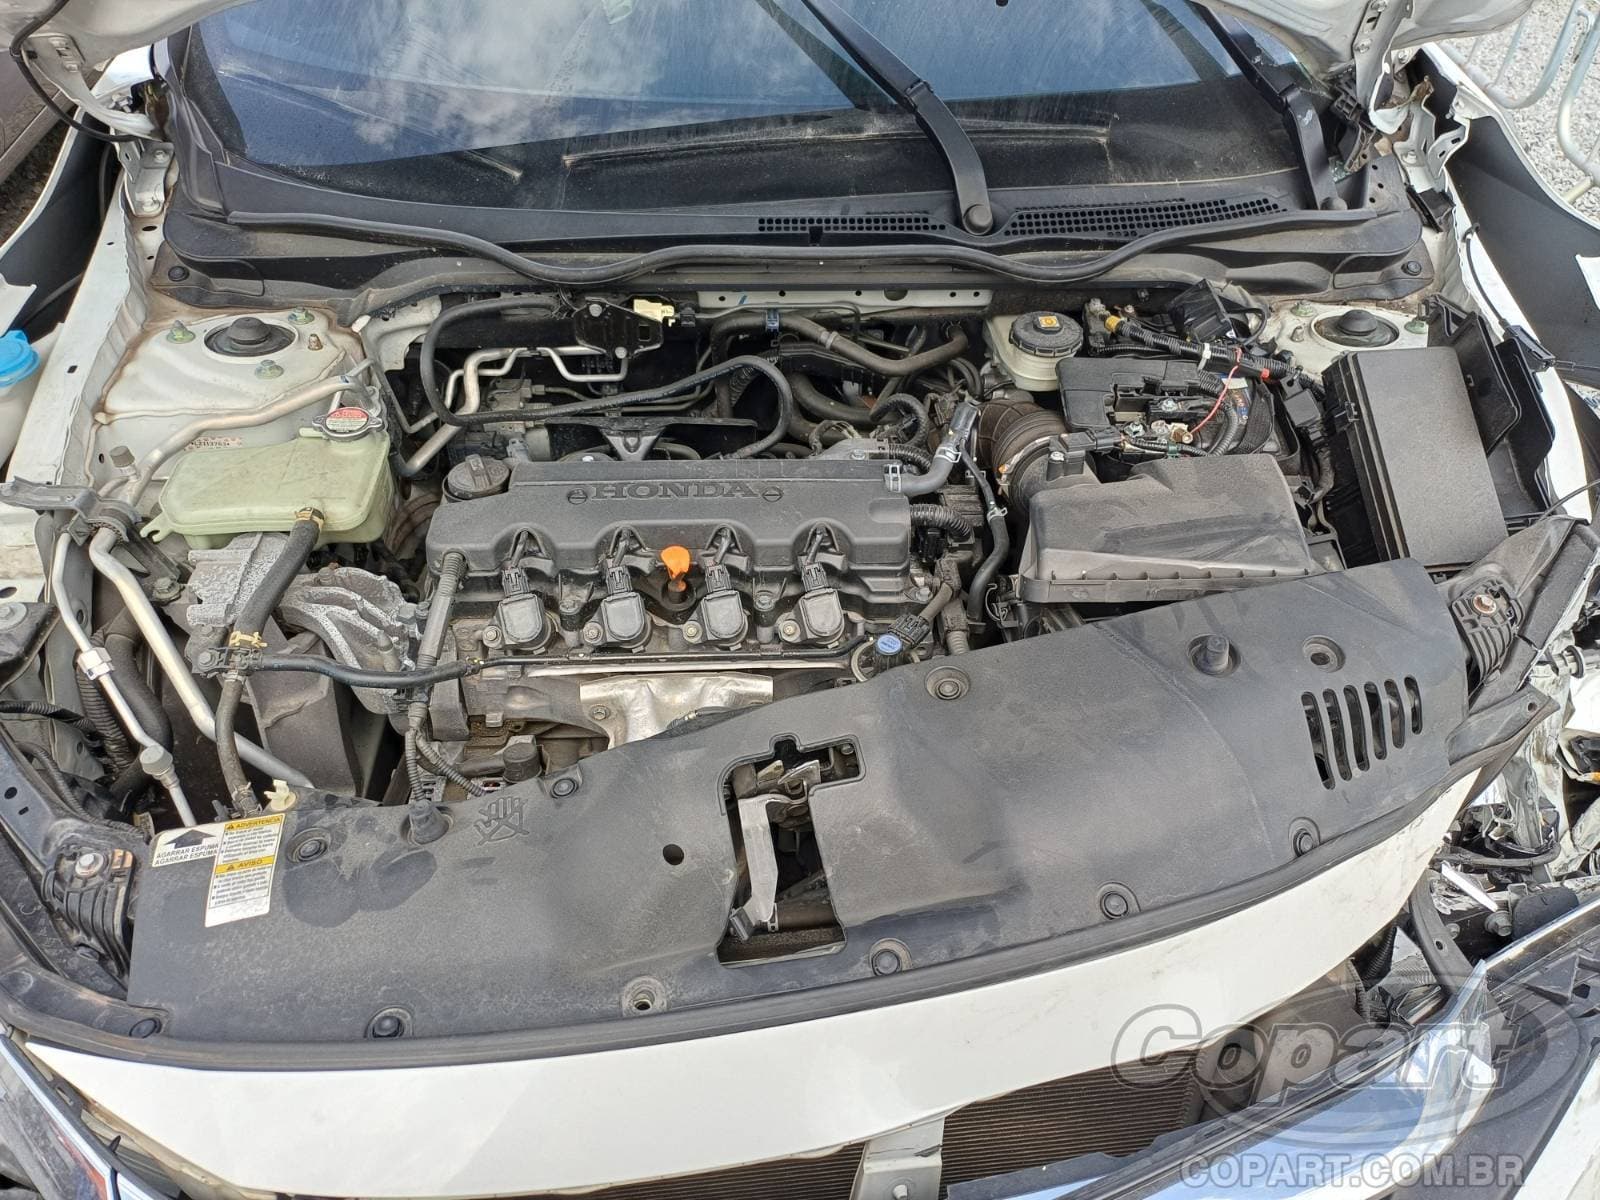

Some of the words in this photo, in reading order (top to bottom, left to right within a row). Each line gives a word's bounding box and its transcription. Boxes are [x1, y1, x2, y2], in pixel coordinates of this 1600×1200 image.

[592, 481, 760, 499] HONDA
[156, 848, 190, 859] AGARRAR
[239, 858, 263, 868] AVISO
